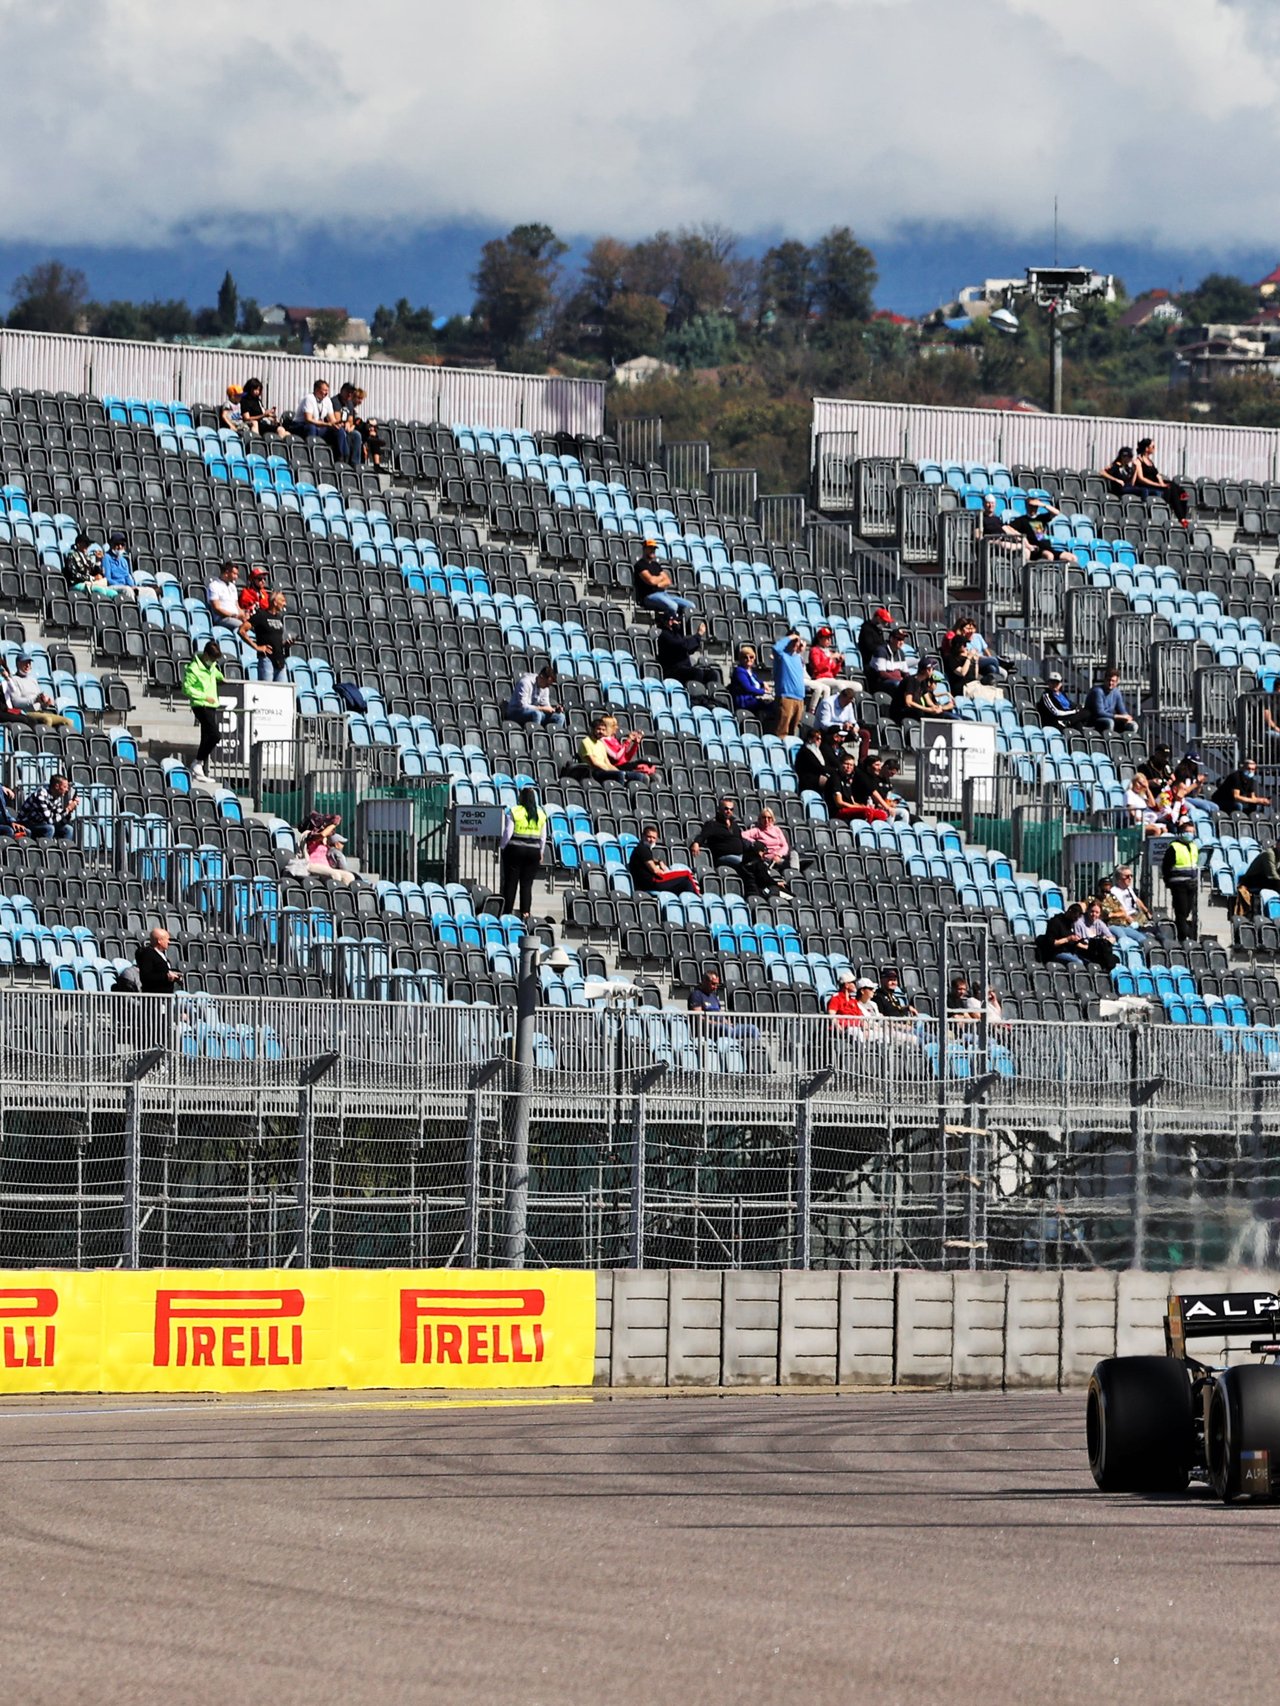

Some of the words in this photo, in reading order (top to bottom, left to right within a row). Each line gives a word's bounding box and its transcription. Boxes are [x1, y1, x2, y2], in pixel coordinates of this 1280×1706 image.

[929, 734, 949, 770] 4
[153, 1288, 305, 1367] PIRELLI
[399, 1288, 545, 1365] PIRELLI
